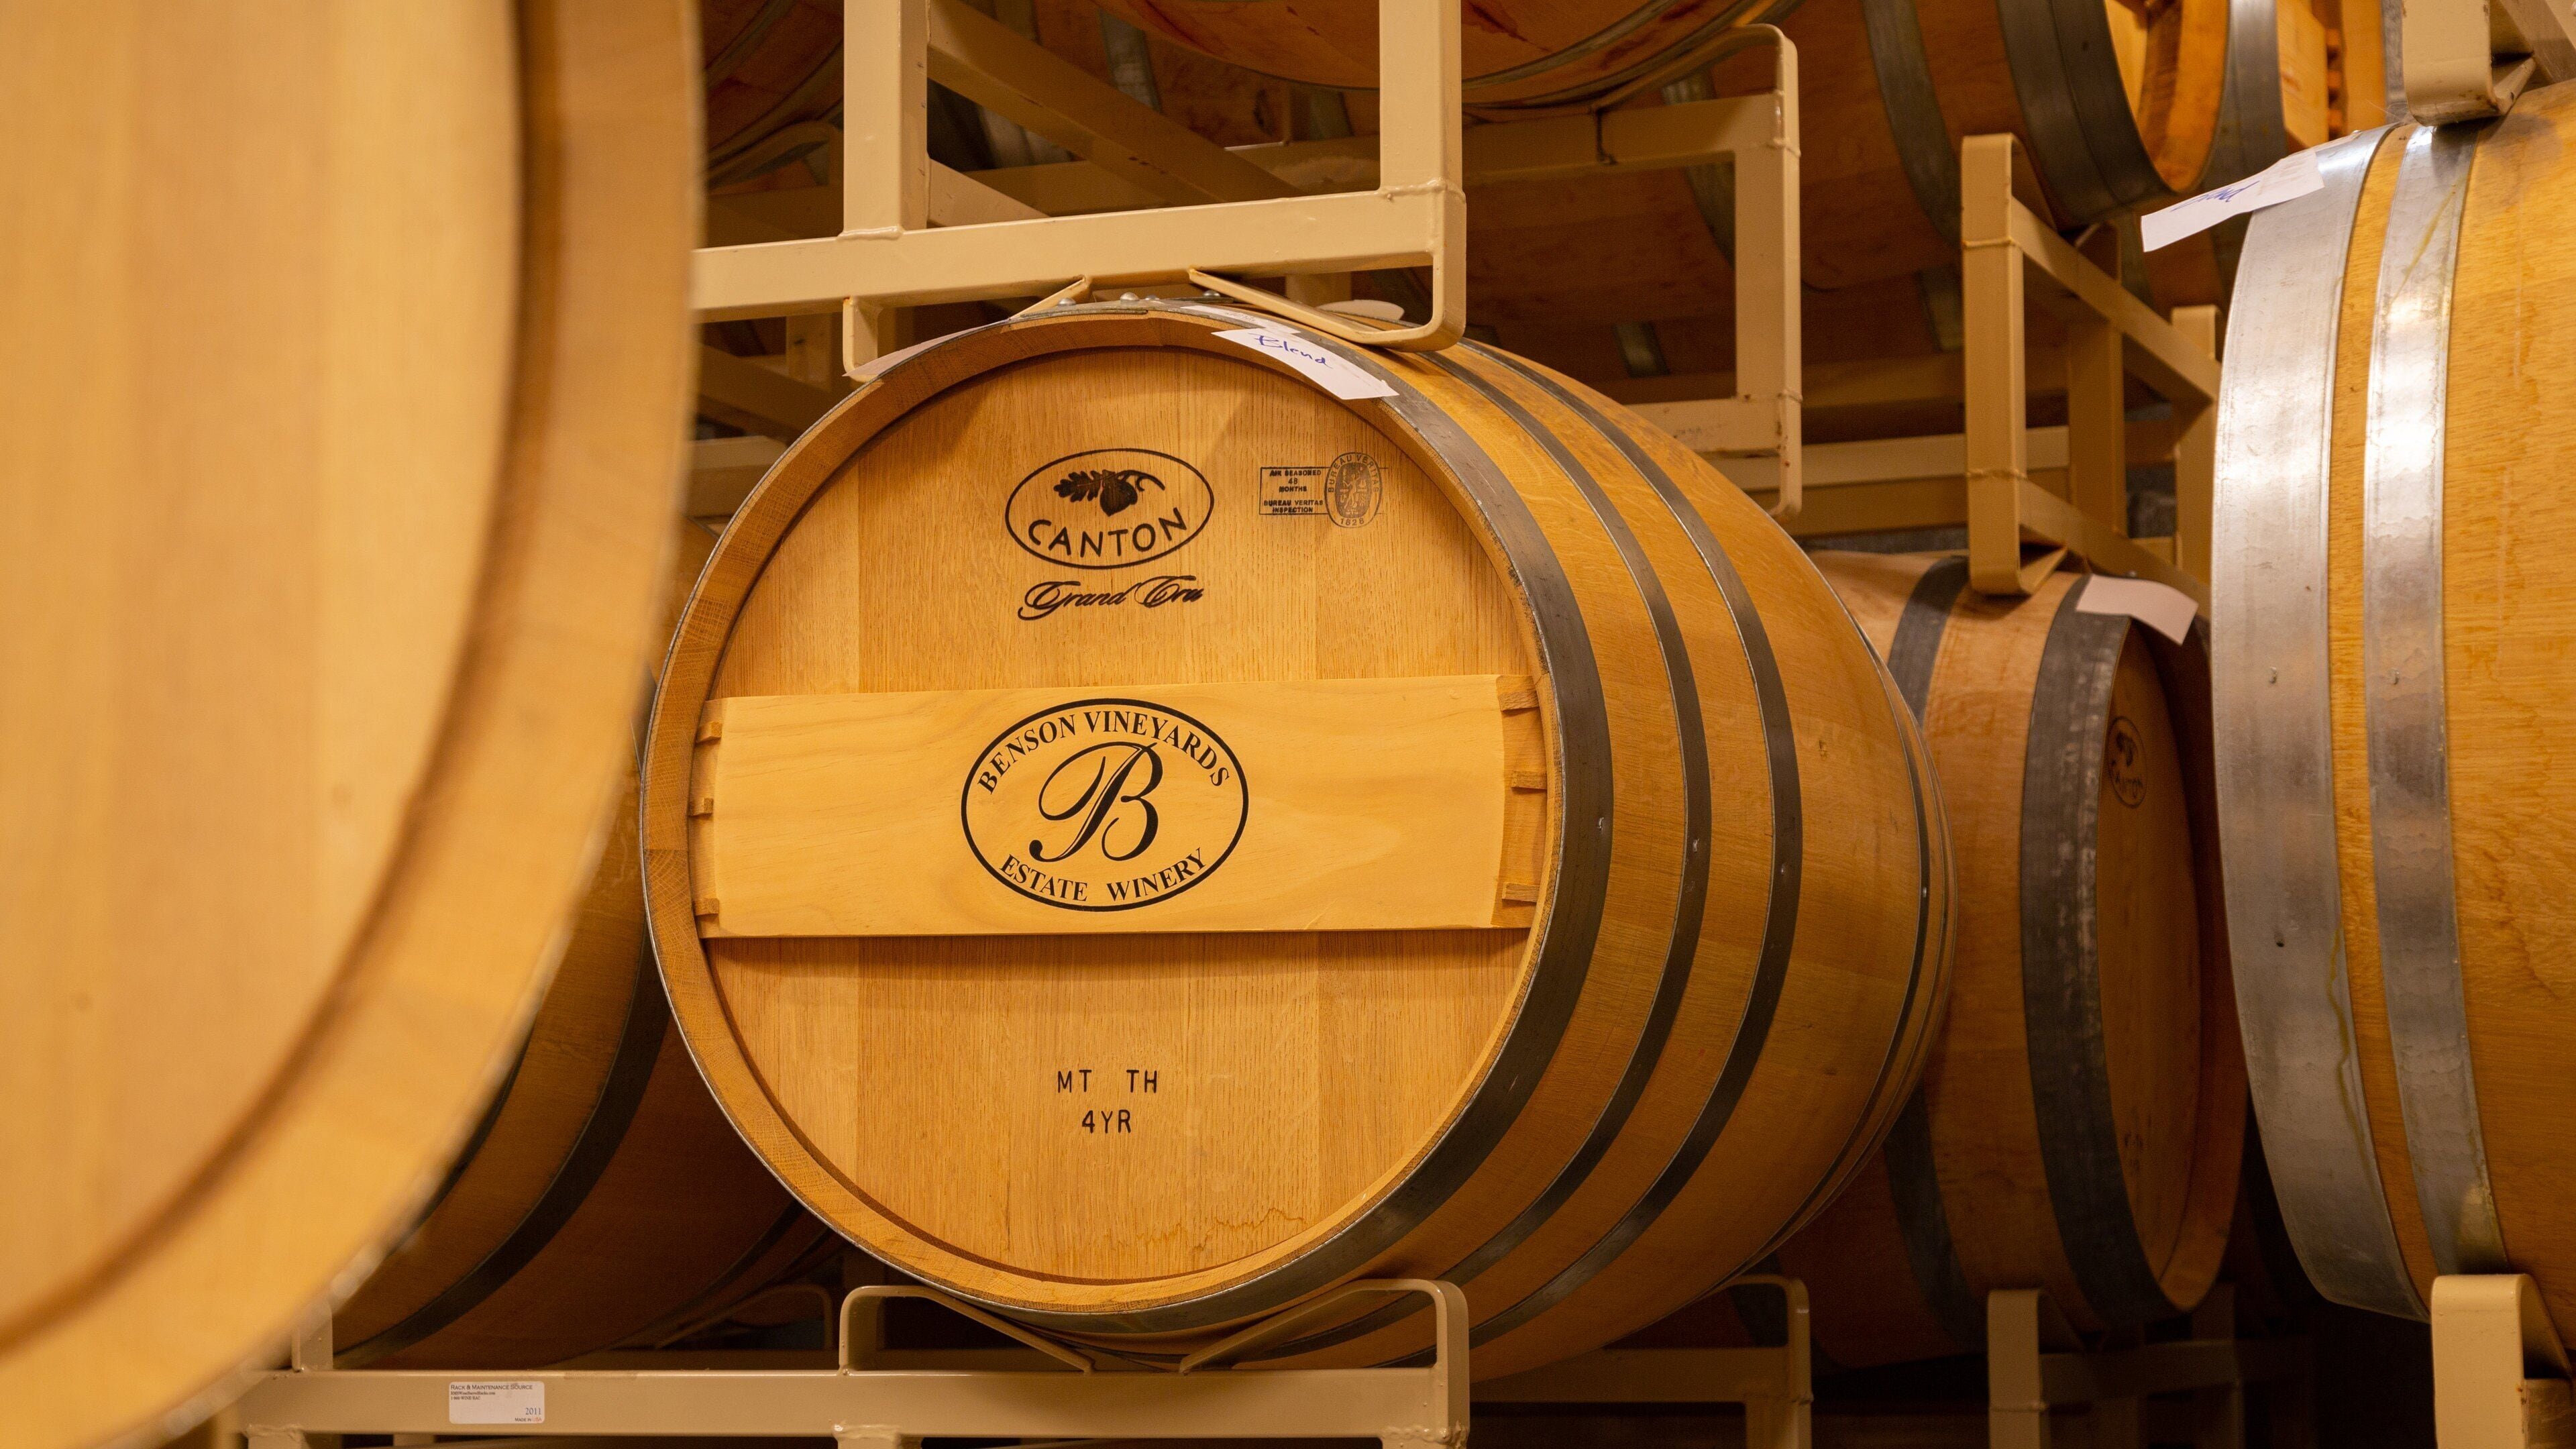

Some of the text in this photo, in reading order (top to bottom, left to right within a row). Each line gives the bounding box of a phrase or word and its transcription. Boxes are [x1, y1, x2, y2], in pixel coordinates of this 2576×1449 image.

[1249, 333, 1333, 370] Blend
[1328, 454, 1379, 493] BUREAU VERITAS
[1028, 507, 1187, 557] CANTON
[1018, 575, 1204, 621] Grand Cru
[977, 710, 1230, 794] BENSON VINEYARDS
[1029, 741, 1163, 862] B
[999, 847, 1207, 902] ESTATE WINERY
[1058, 1069, 1157, 1093] MT TH
[1082, 1110, 1132, 1134] 4YR
[525, 1407, 541, 1415] 2011
